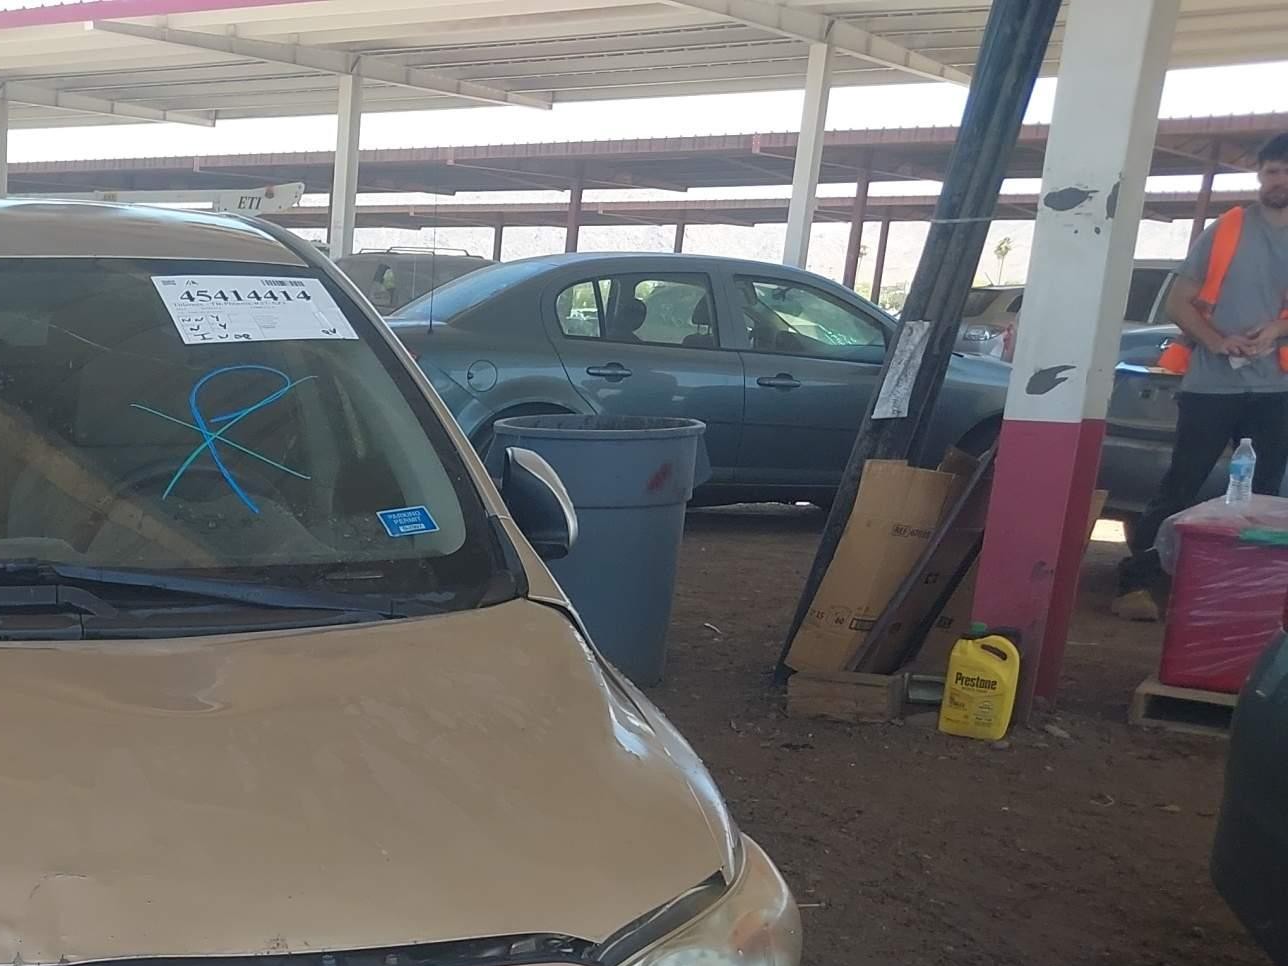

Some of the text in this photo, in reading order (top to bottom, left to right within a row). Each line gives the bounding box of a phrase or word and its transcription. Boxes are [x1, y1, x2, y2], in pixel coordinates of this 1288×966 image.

[237, 195, 262, 210] ETI
[179, 289, 312, 303] 45414414
[391, 510, 421, 519] PARKING
[393, 516, 421, 525] PERMIT
[954, 672, 998, 690] Prestone
